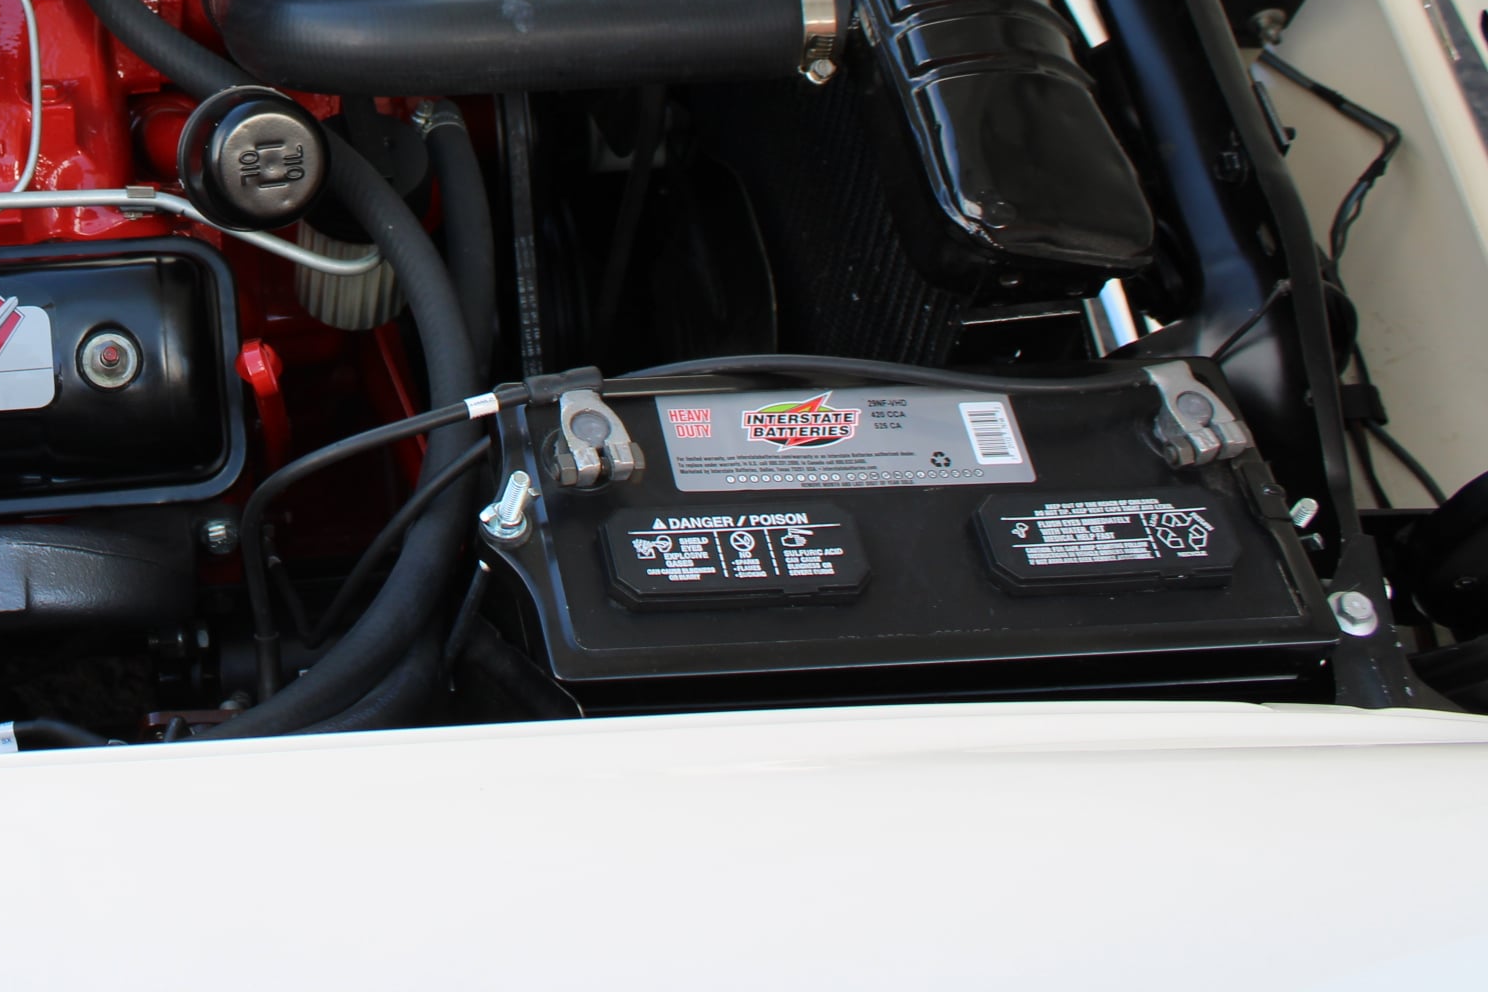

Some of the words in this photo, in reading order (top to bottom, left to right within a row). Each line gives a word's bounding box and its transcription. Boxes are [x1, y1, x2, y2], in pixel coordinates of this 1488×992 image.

[239, 150, 261, 186] OIL
[284, 144, 305, 181] OIL
[669, 408, 711, 423] HEAVY
[746, 413, 854, 425] INTERSTATE
[887, 410, 906, 418] CCA
[676, 424, 711, 438] DUTY
[753, 426, 849, 437] BATTERIES
[889, 421, 902, 429] CA
[668, 516, 734, 529] DANGER
[749, 512, 809, 526] POISON
